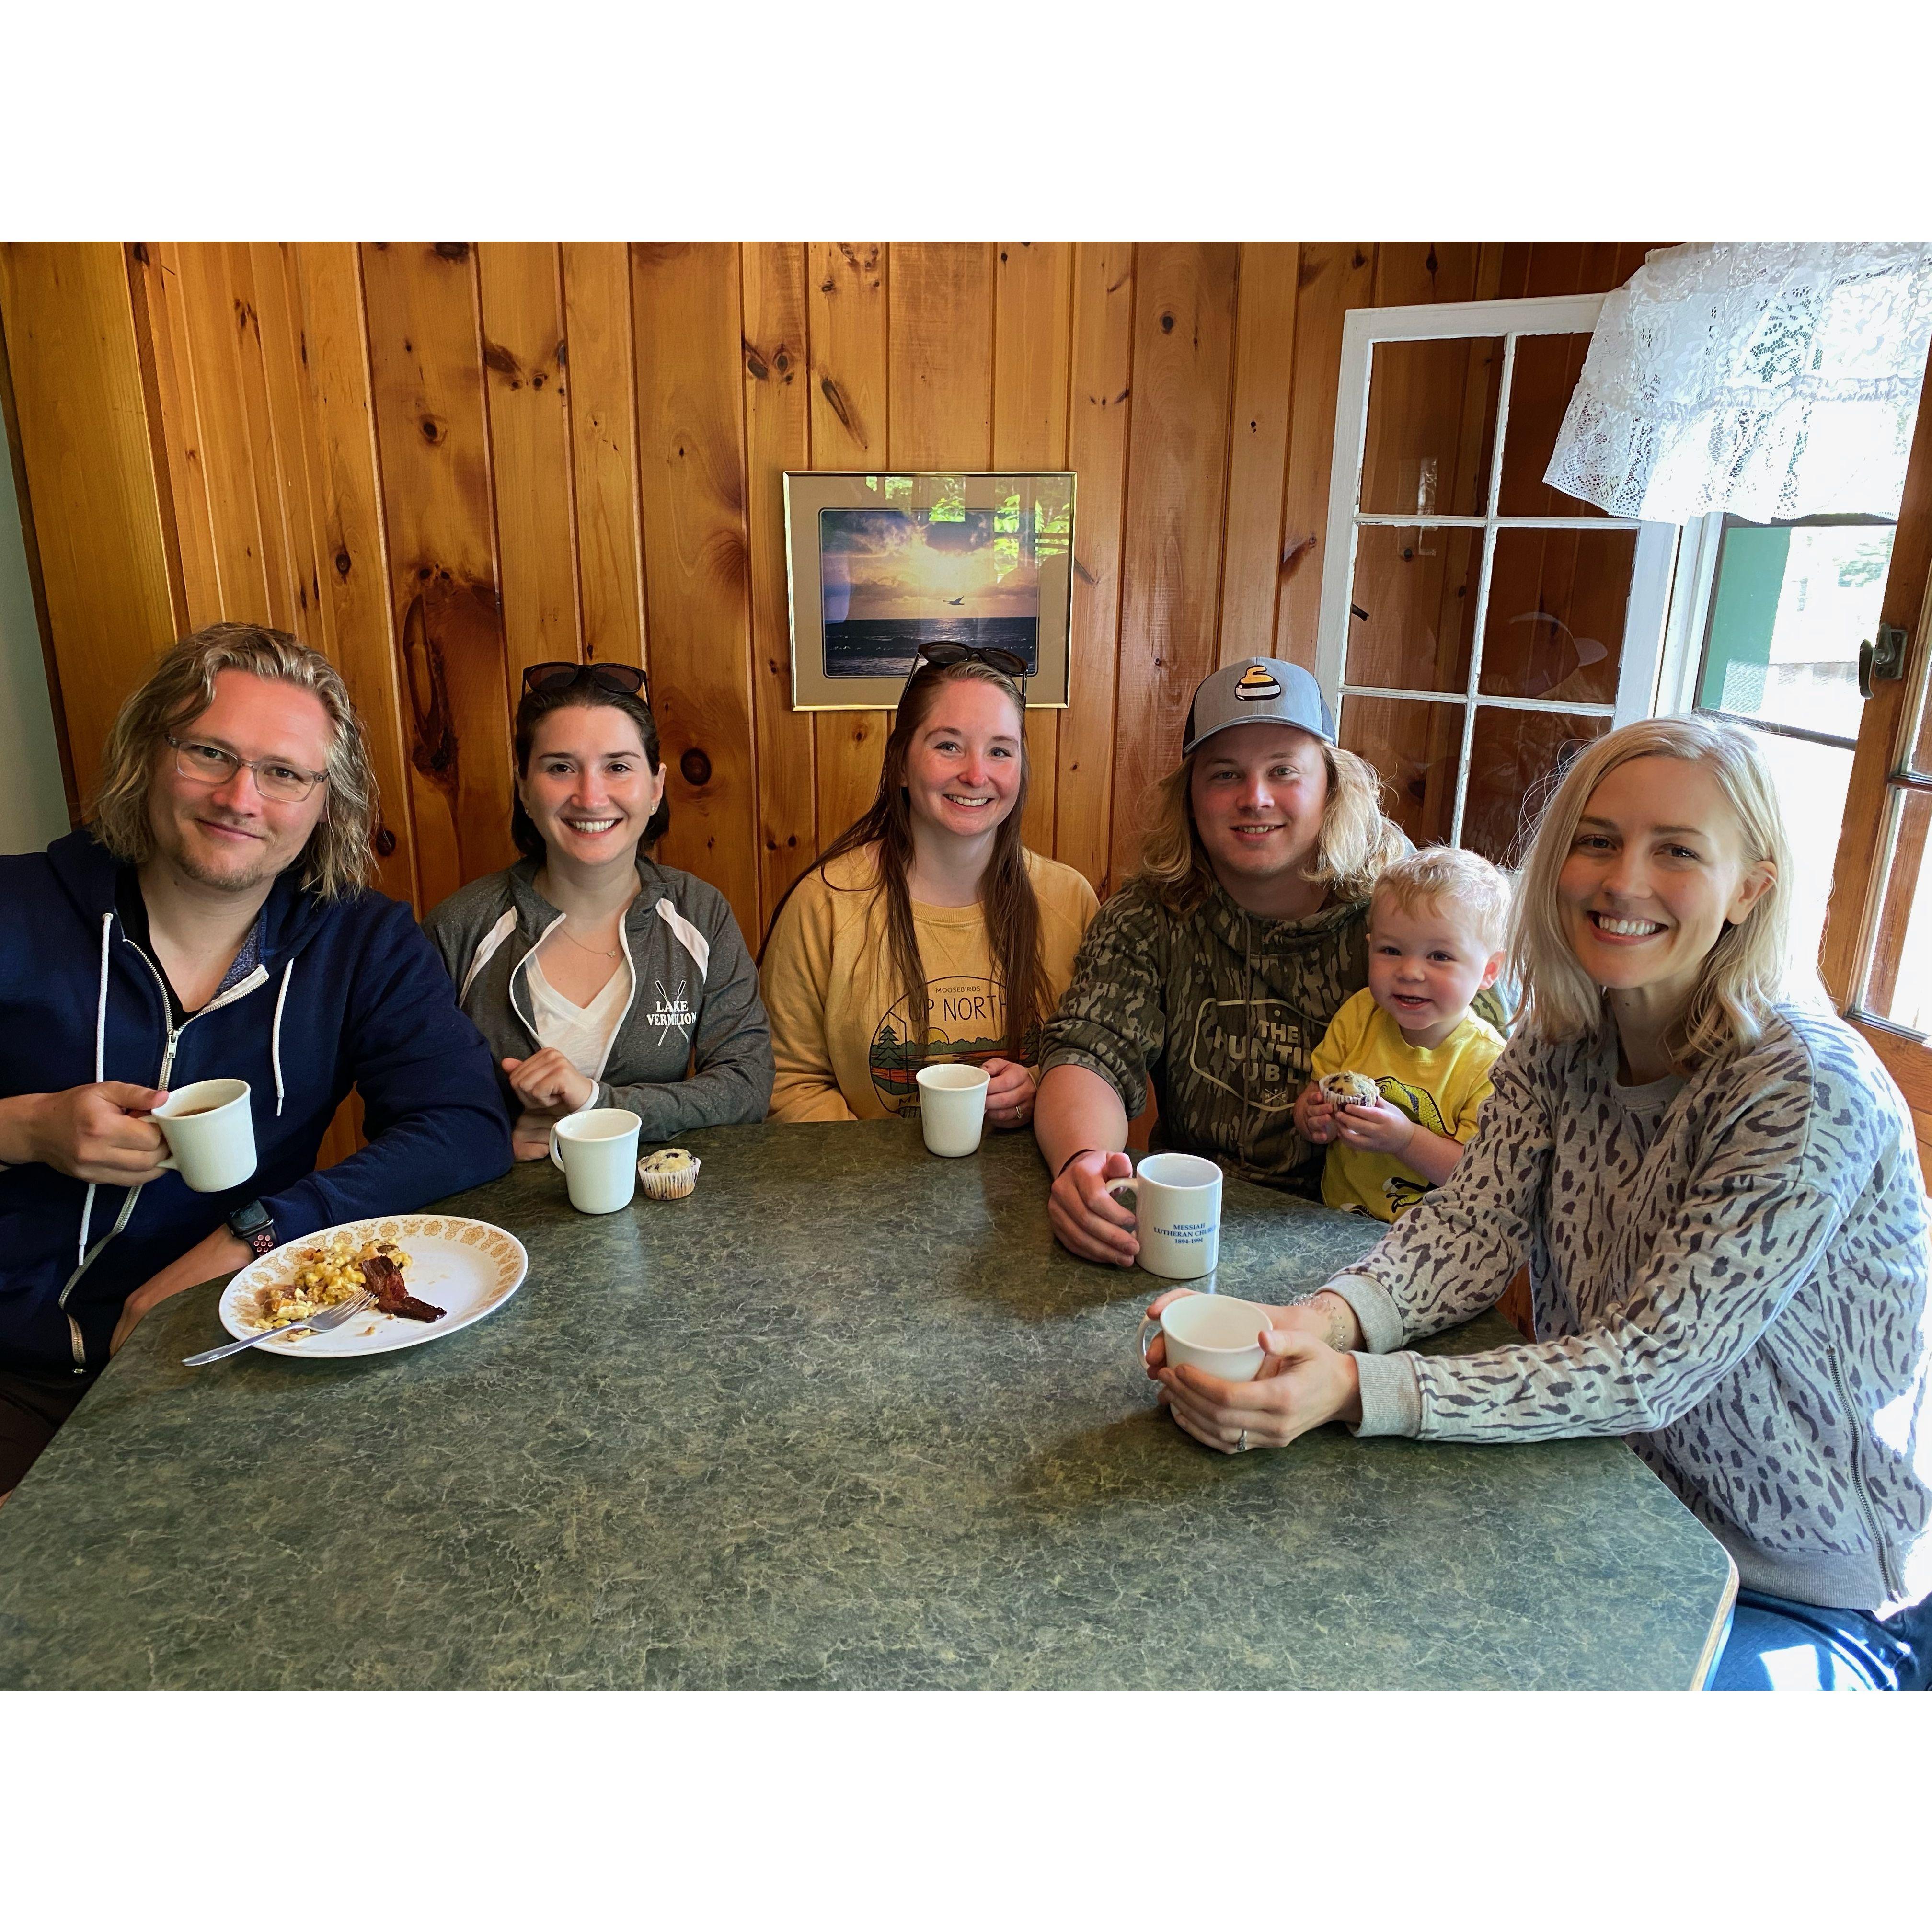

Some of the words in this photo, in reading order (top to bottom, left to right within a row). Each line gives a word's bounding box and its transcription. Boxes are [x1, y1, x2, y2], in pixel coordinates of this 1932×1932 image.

[935, 985, 981, 993] MOOSEBIRDS
[656, 1000, 689, 1012] LAKE
[646, 1012, 697, 1026] VERMILION
[1258, 1020, 1299, 1044] THE
[1154, 1227, 1193, 1237] LUTHERAN
